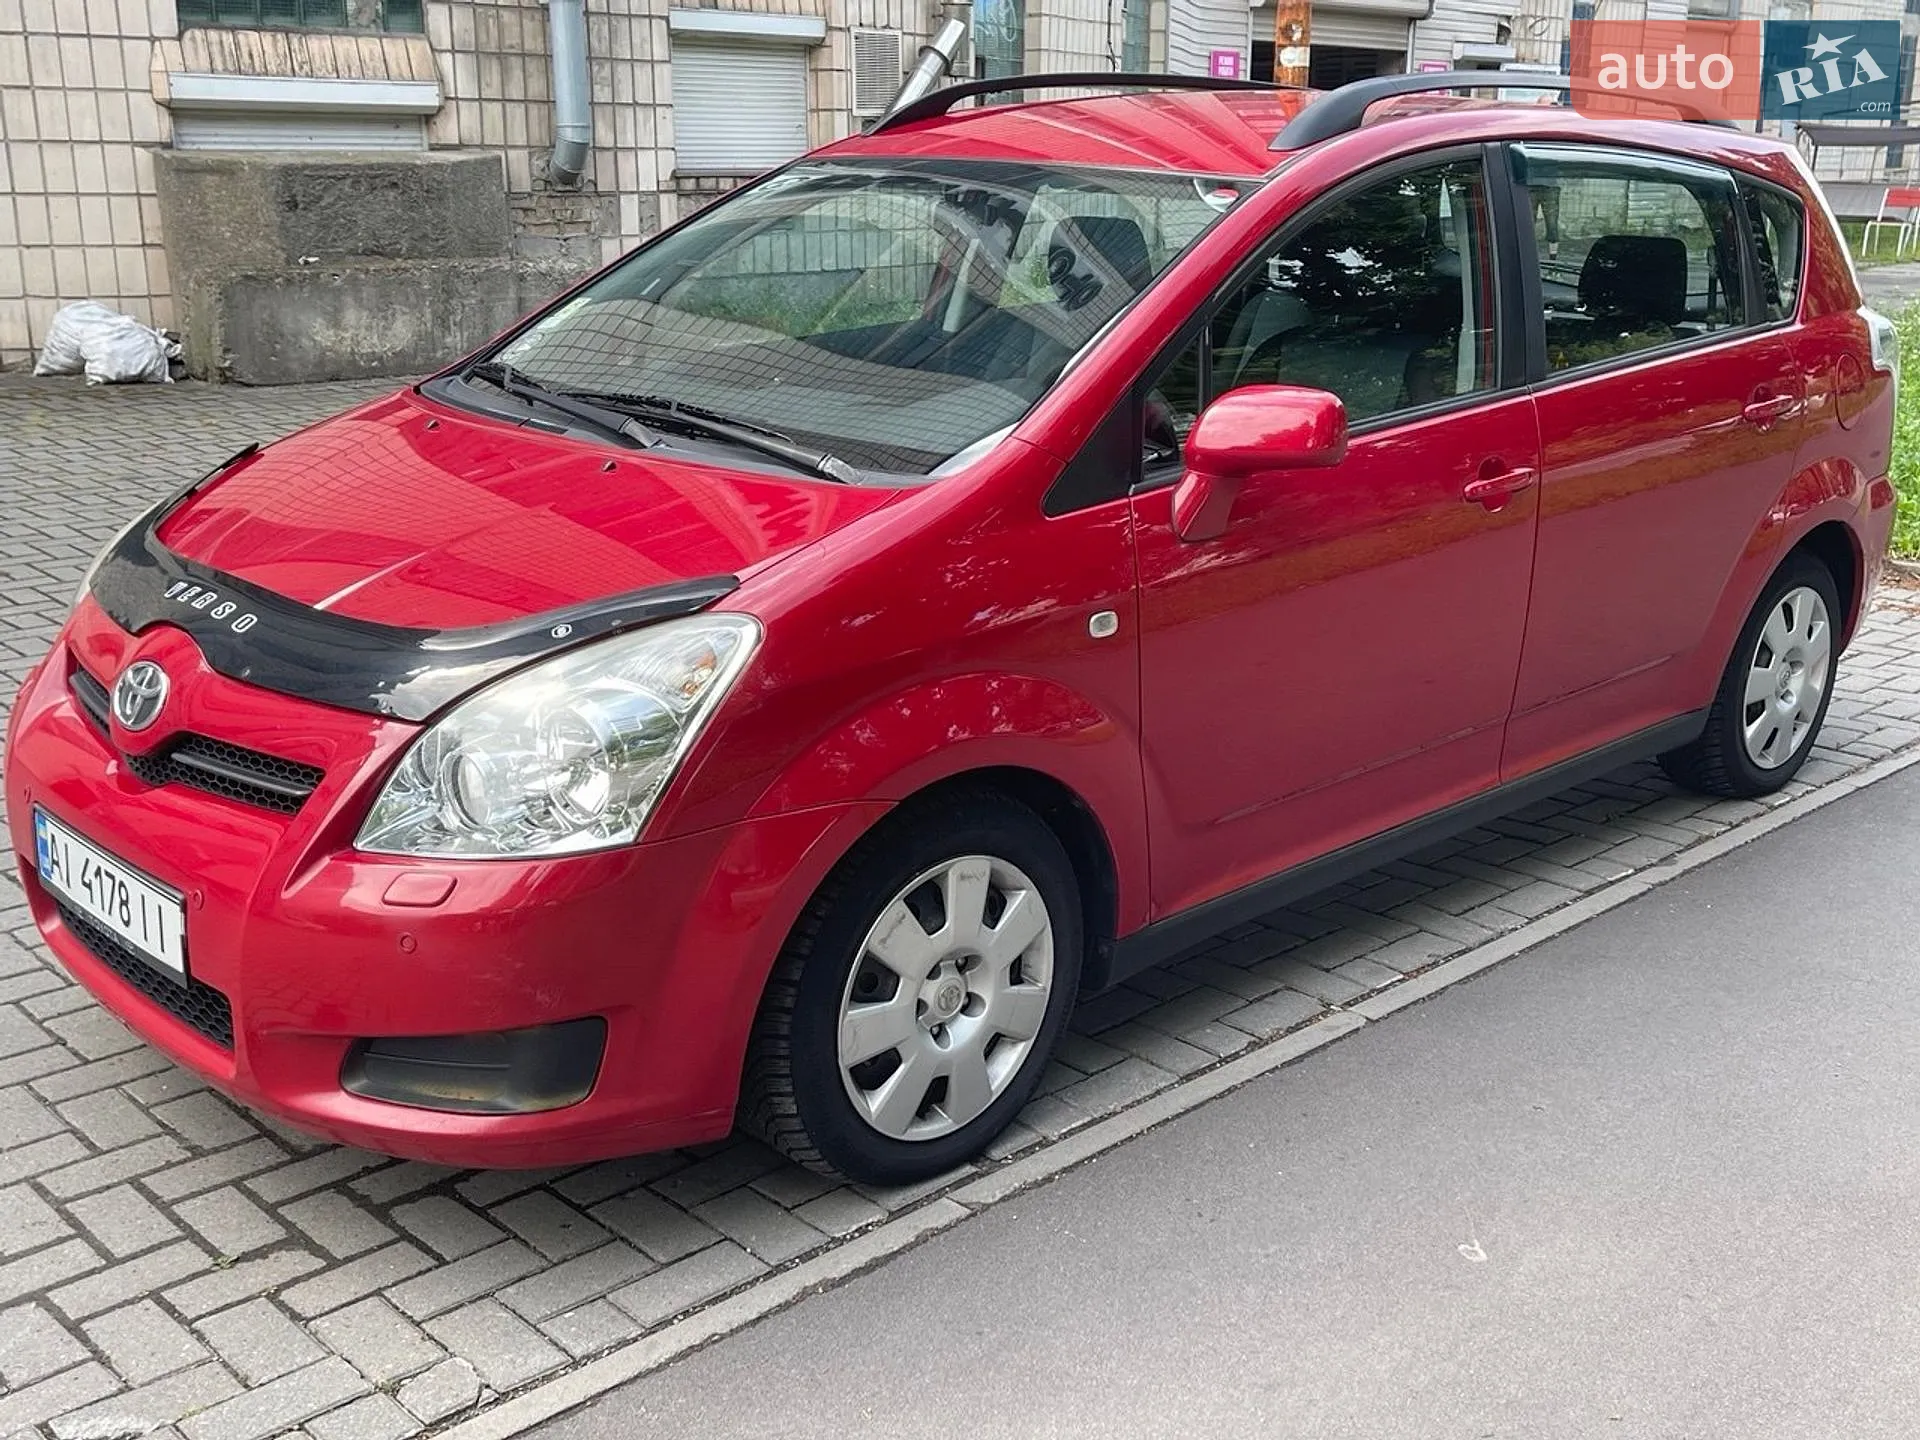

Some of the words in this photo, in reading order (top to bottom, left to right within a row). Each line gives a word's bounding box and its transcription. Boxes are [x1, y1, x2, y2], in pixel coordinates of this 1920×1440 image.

[164, 581, 258, 633] VERSO
[51, 833, 71, 889] AI
[81, 857, 131, 928] 4178
[141, 893, 165, 954] II
